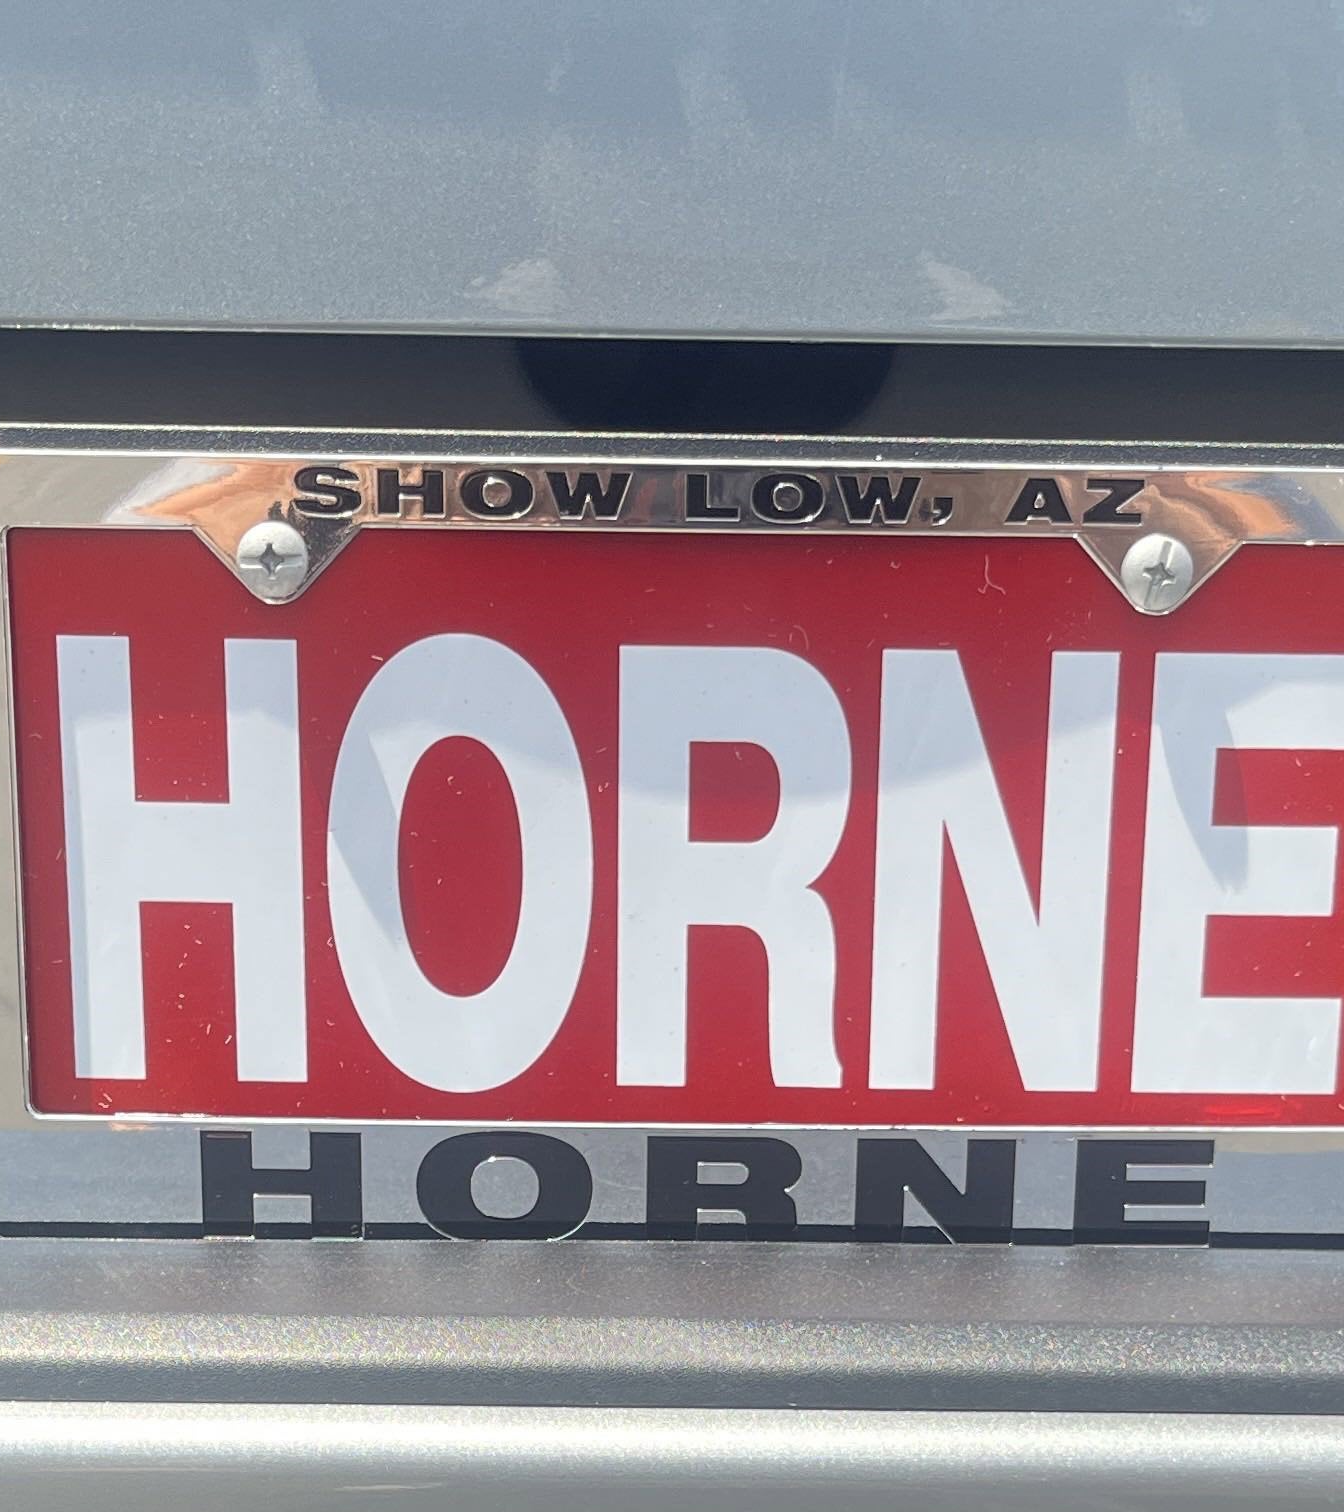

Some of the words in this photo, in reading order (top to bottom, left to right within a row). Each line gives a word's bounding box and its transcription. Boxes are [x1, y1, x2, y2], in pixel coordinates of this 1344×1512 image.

[292, 466, 634, 521] SHOW
[684, 472, 954, 526] LOW,
[1003, 476, 1147, 528] AZ
[200, 1130, 1214, 1248] HORNE
